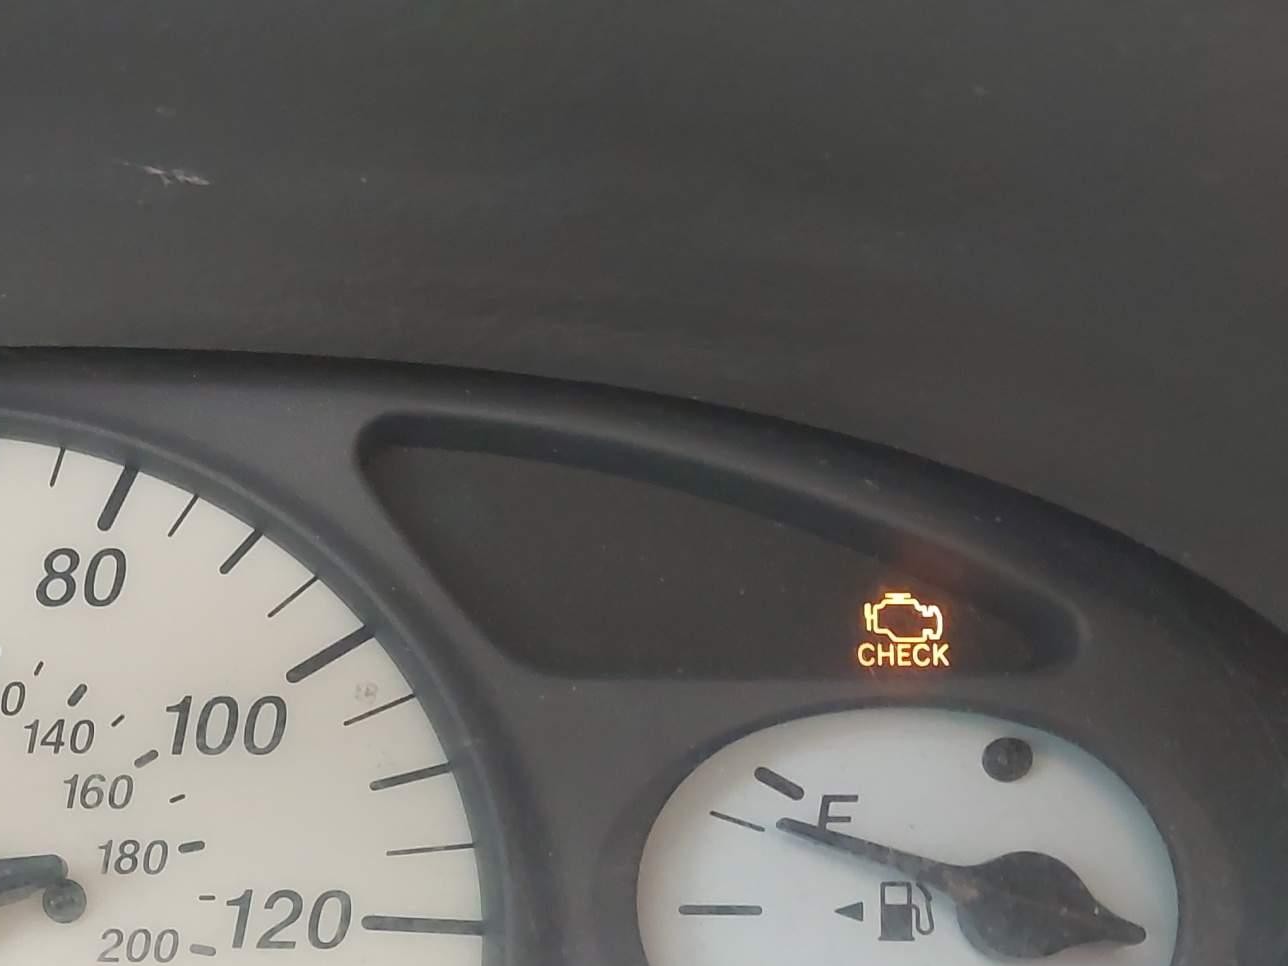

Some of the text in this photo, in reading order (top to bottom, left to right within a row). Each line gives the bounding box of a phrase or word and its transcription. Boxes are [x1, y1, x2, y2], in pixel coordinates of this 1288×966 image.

[35, 548, 127, 607] 80
[857, 643, 950, 667] CHECK
[24, 719, 95, 754] 140
[165, 696, 288, 756] 100
[63, 774, 133, 809] 160
[98, 839, 168, 875] 180
[225, 889, 352, 949] 120
[97, 928, 179, 963] 200
